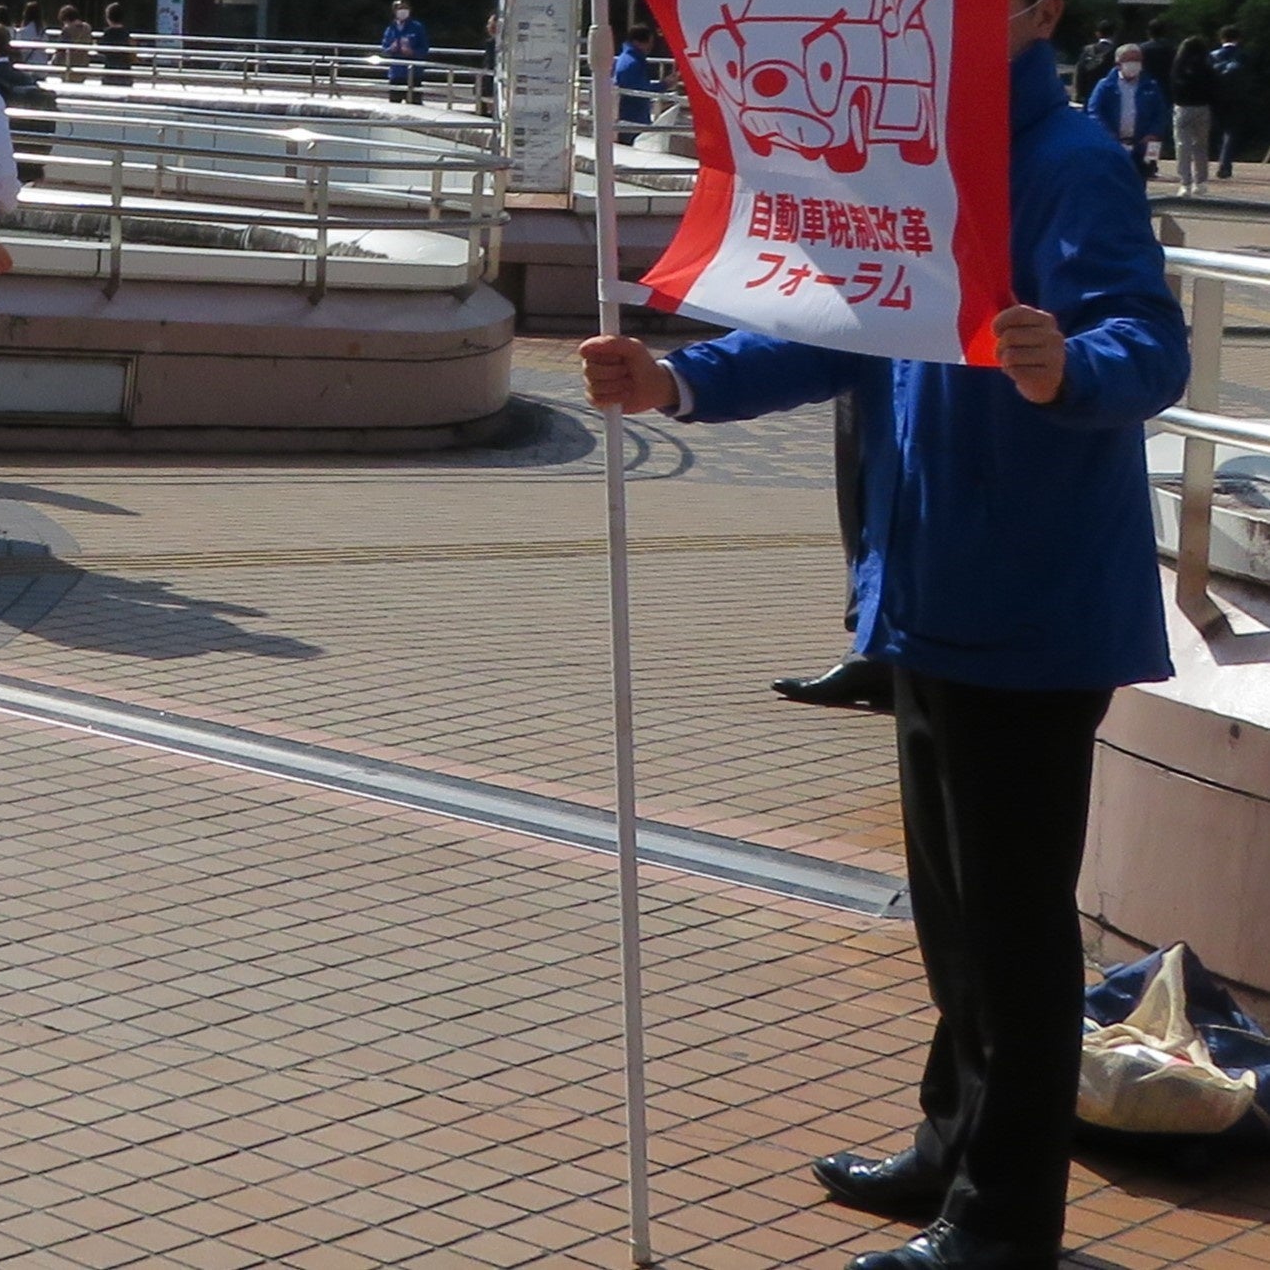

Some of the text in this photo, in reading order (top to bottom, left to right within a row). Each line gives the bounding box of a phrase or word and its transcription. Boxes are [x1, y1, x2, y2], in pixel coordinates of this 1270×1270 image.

[545, 3, 554, 18] 6
[747, 194, 932, 258] 自動車税制改革
[745, 253, 913, 311] フォーラム
